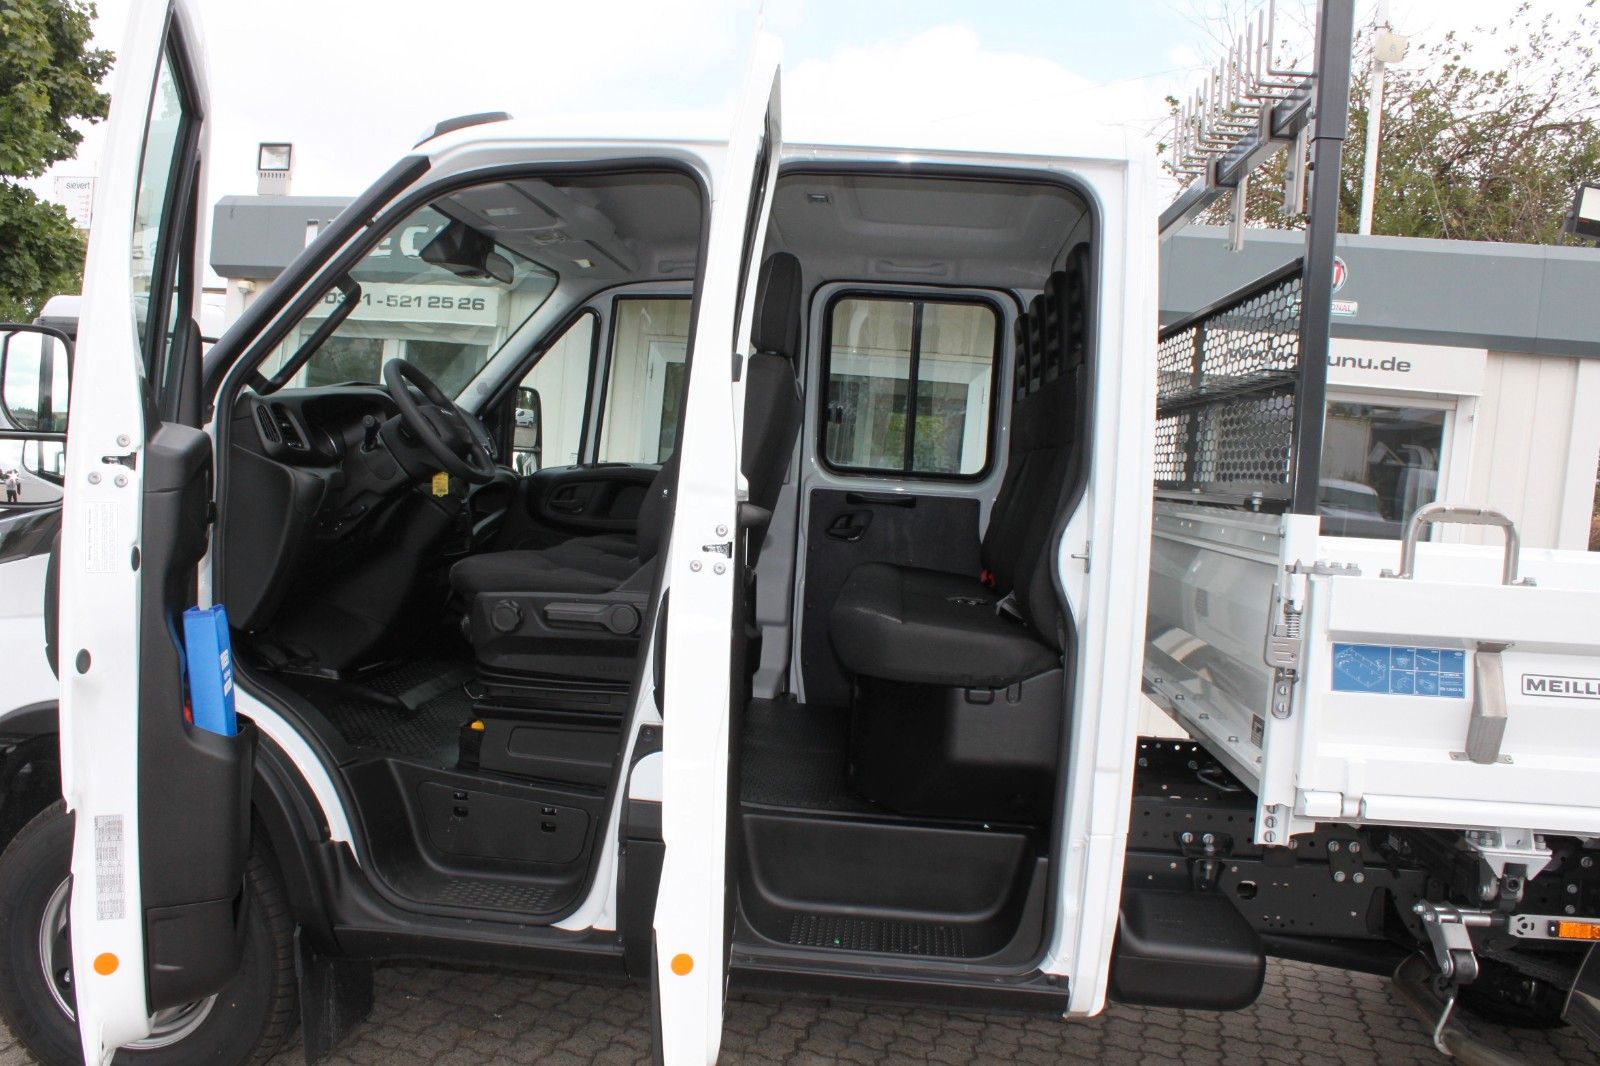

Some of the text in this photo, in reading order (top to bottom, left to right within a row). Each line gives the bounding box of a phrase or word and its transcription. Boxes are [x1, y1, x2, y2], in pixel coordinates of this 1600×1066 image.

[323, 292, 372, 307] 031
[386, 293, 422, 309] 521
[427, 295, 454, 310] 25
[457, 297, 486, 312] 26
[1328, 356, 1411, 372] unu.de
[1526, 678, 1600, 695] MEILL
